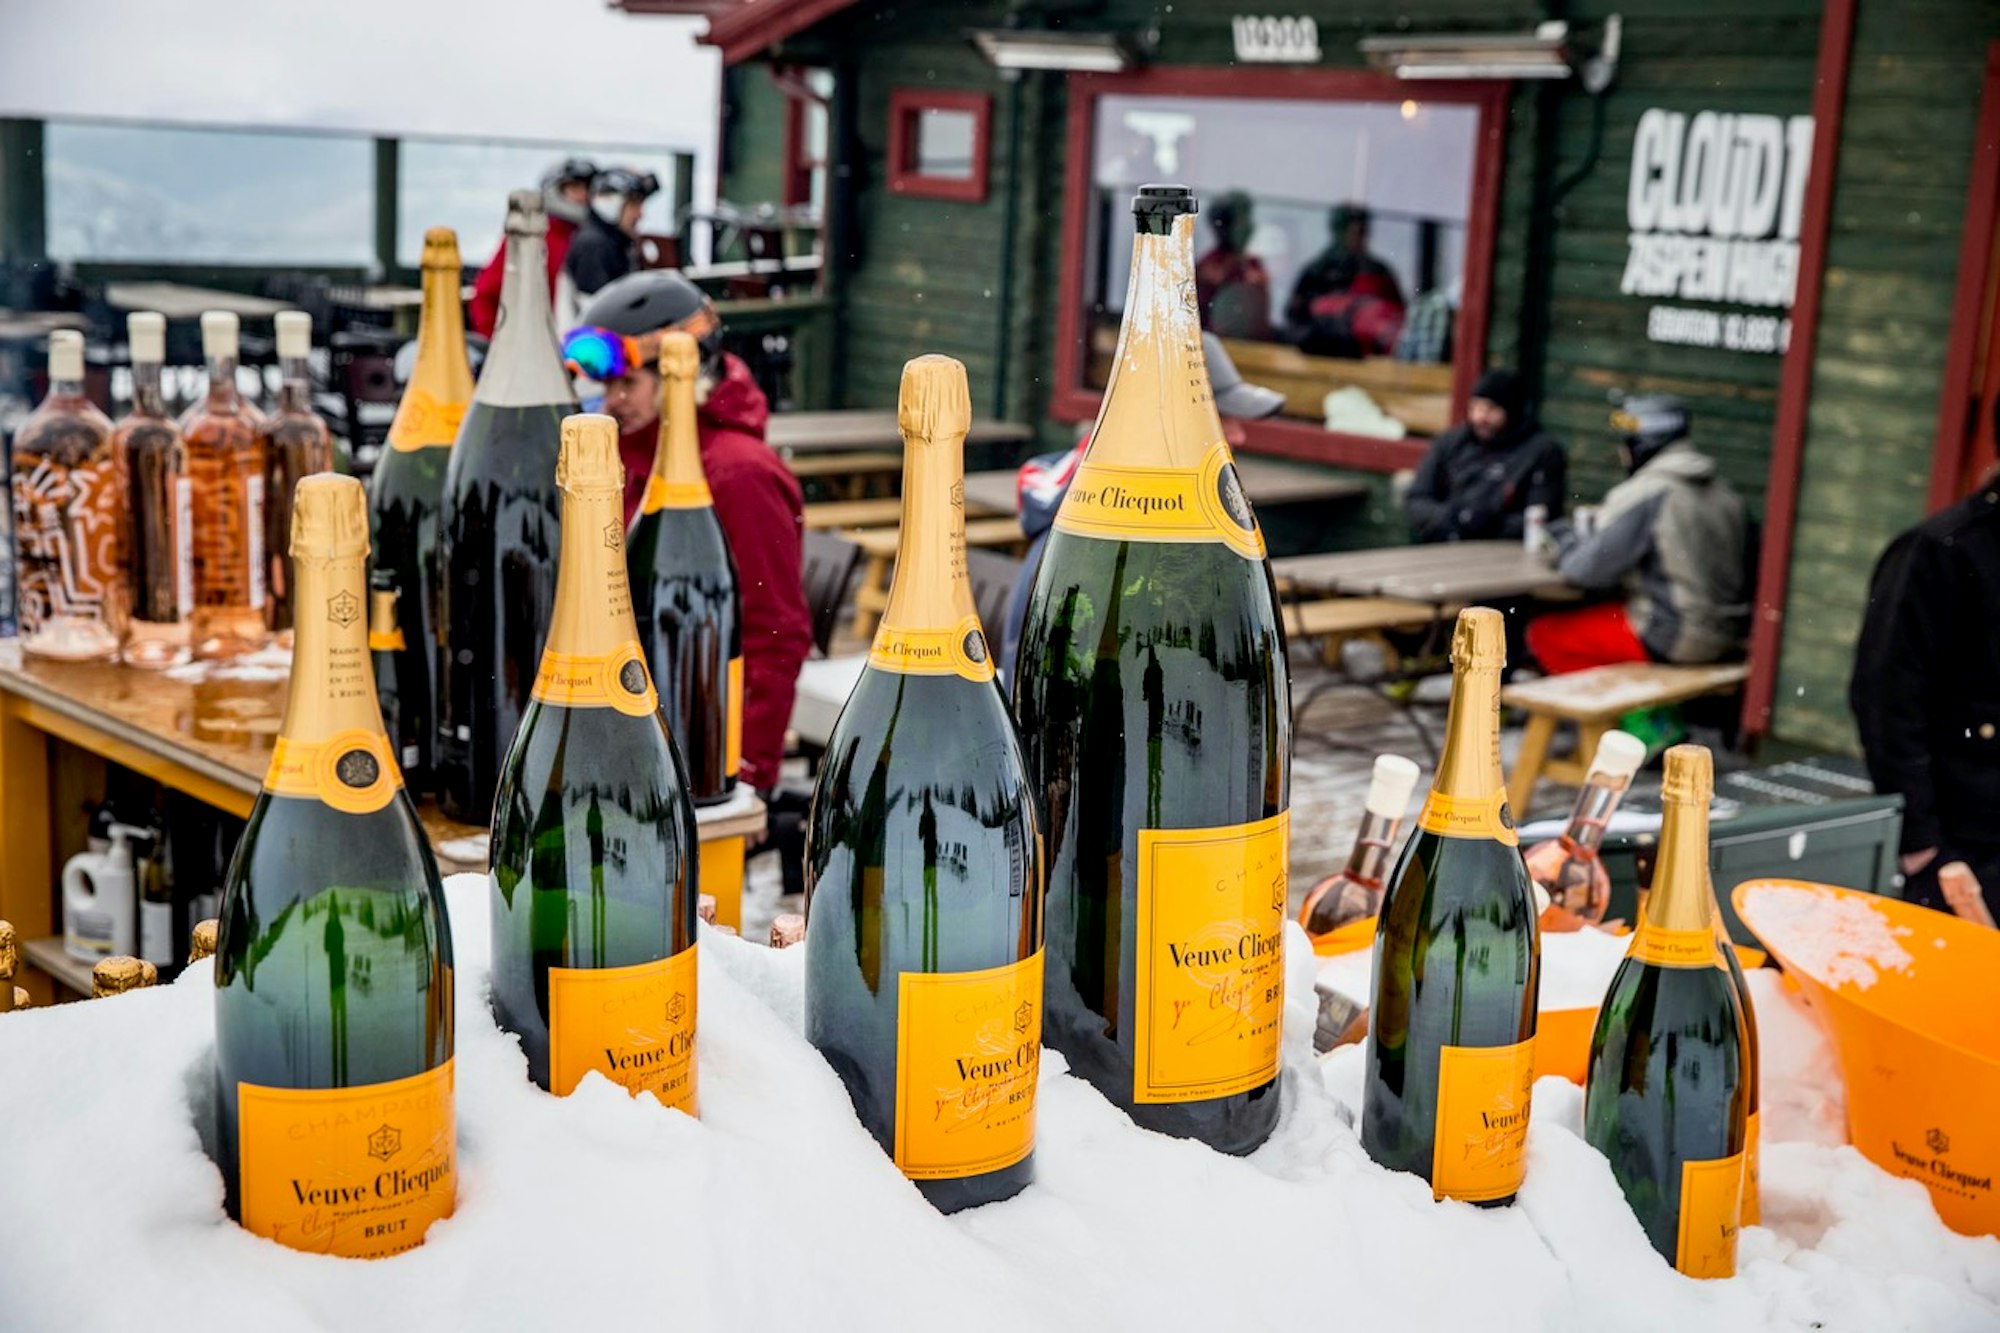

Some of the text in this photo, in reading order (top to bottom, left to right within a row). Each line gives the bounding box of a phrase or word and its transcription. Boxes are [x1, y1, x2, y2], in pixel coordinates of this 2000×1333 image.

[1627, 107, 1786, 238] CLOUD
[1620, 232, 1729, 302] ASPEN
[1100, 485, 1184, 515] Clicquot
[893, 642, 942, 659] Clicquot
[1168, 942, 1232, 969] Veuve
[605, 1047, 665, 1071] Veuve
[956, 1057, 1012, 1081] Veuve
[1481, 1110, 1520, 1130] Veuve
[1890, 1139, 1927, 1169] Veuve
[1930, 1159, 1992, 1191] Clicquot
[291, 1178, 367, 1206] Veuve
[373, 1156, 451, 1201] Clicquot
[365, 1219, 407, 1239] BRUT
